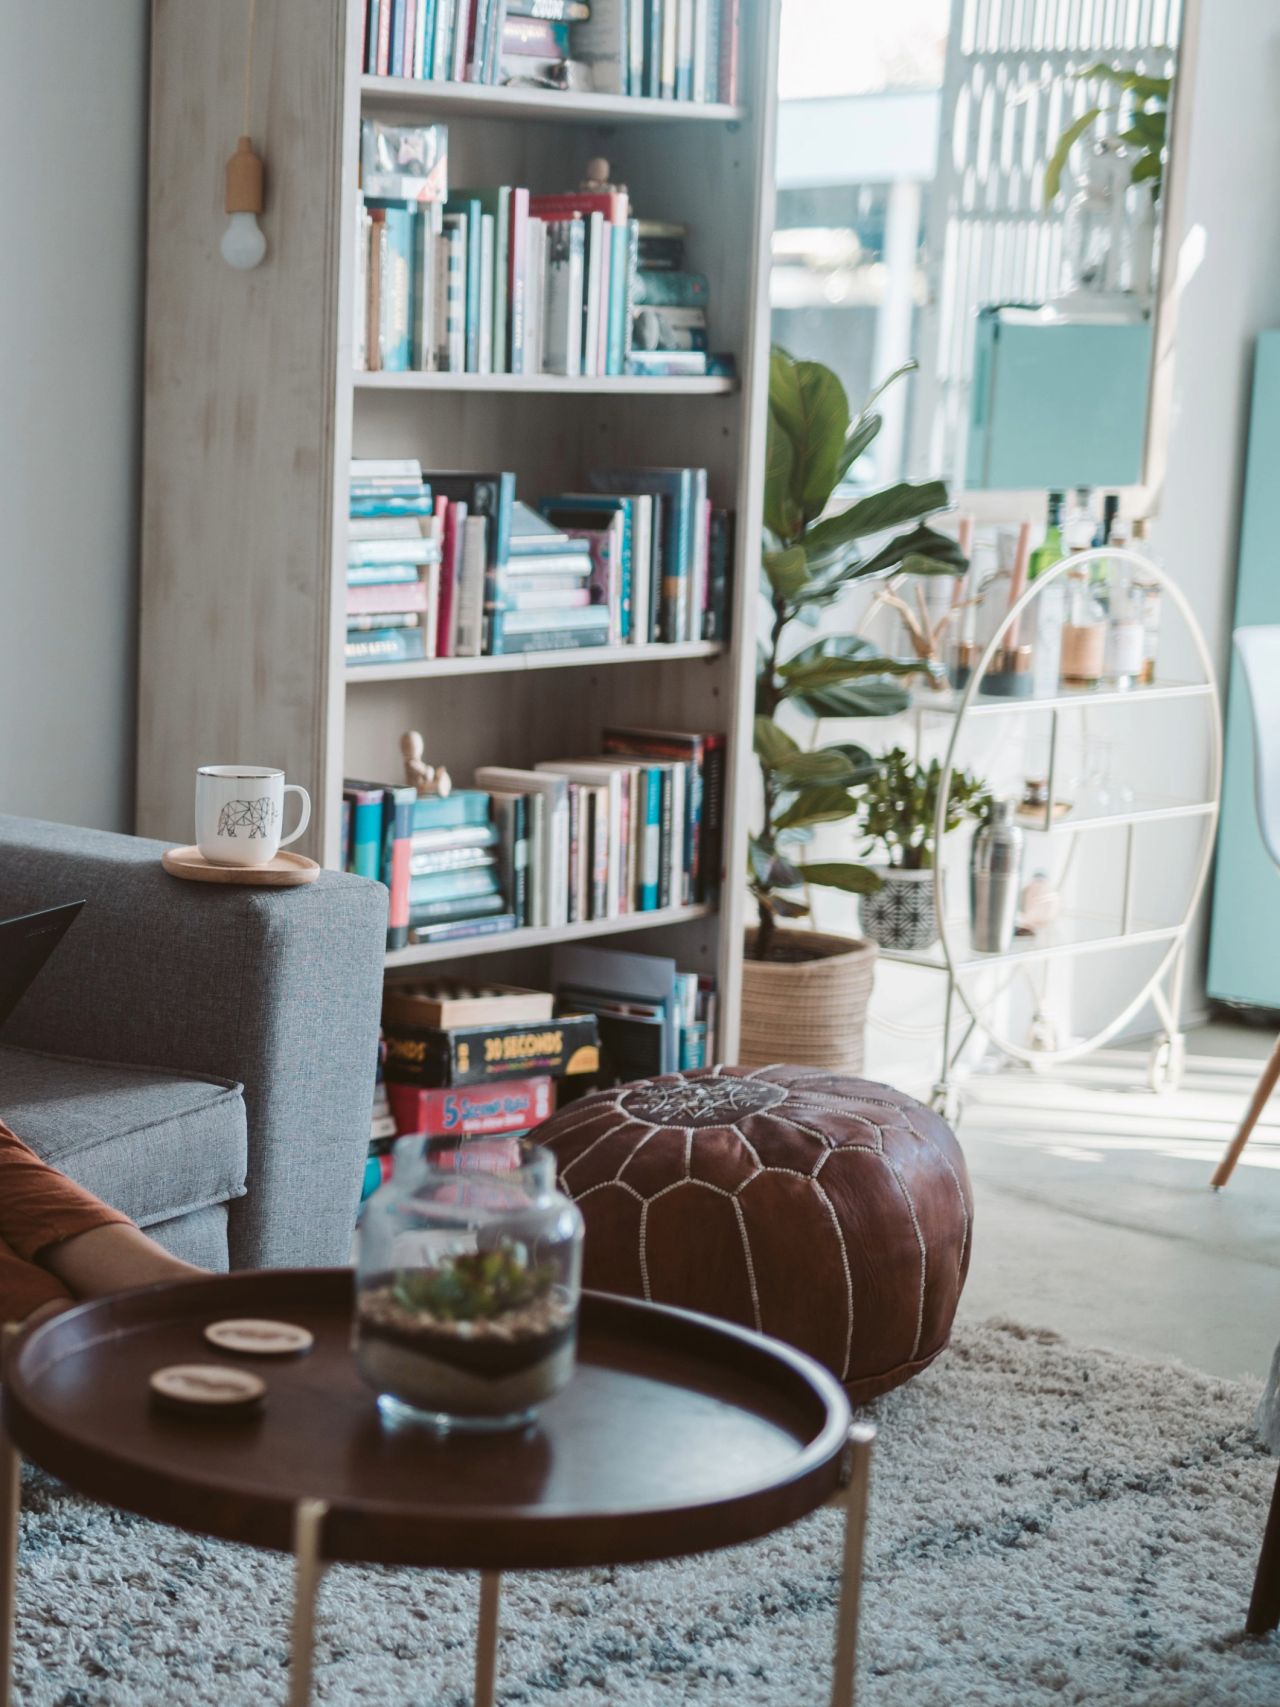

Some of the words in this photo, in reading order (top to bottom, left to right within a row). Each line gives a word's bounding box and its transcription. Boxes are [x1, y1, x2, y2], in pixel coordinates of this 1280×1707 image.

[484, 1037, 502, 1062] 30
[503, 1031, 563, 1058] SECONDS
[442, 1095, 459, 1128] 5
